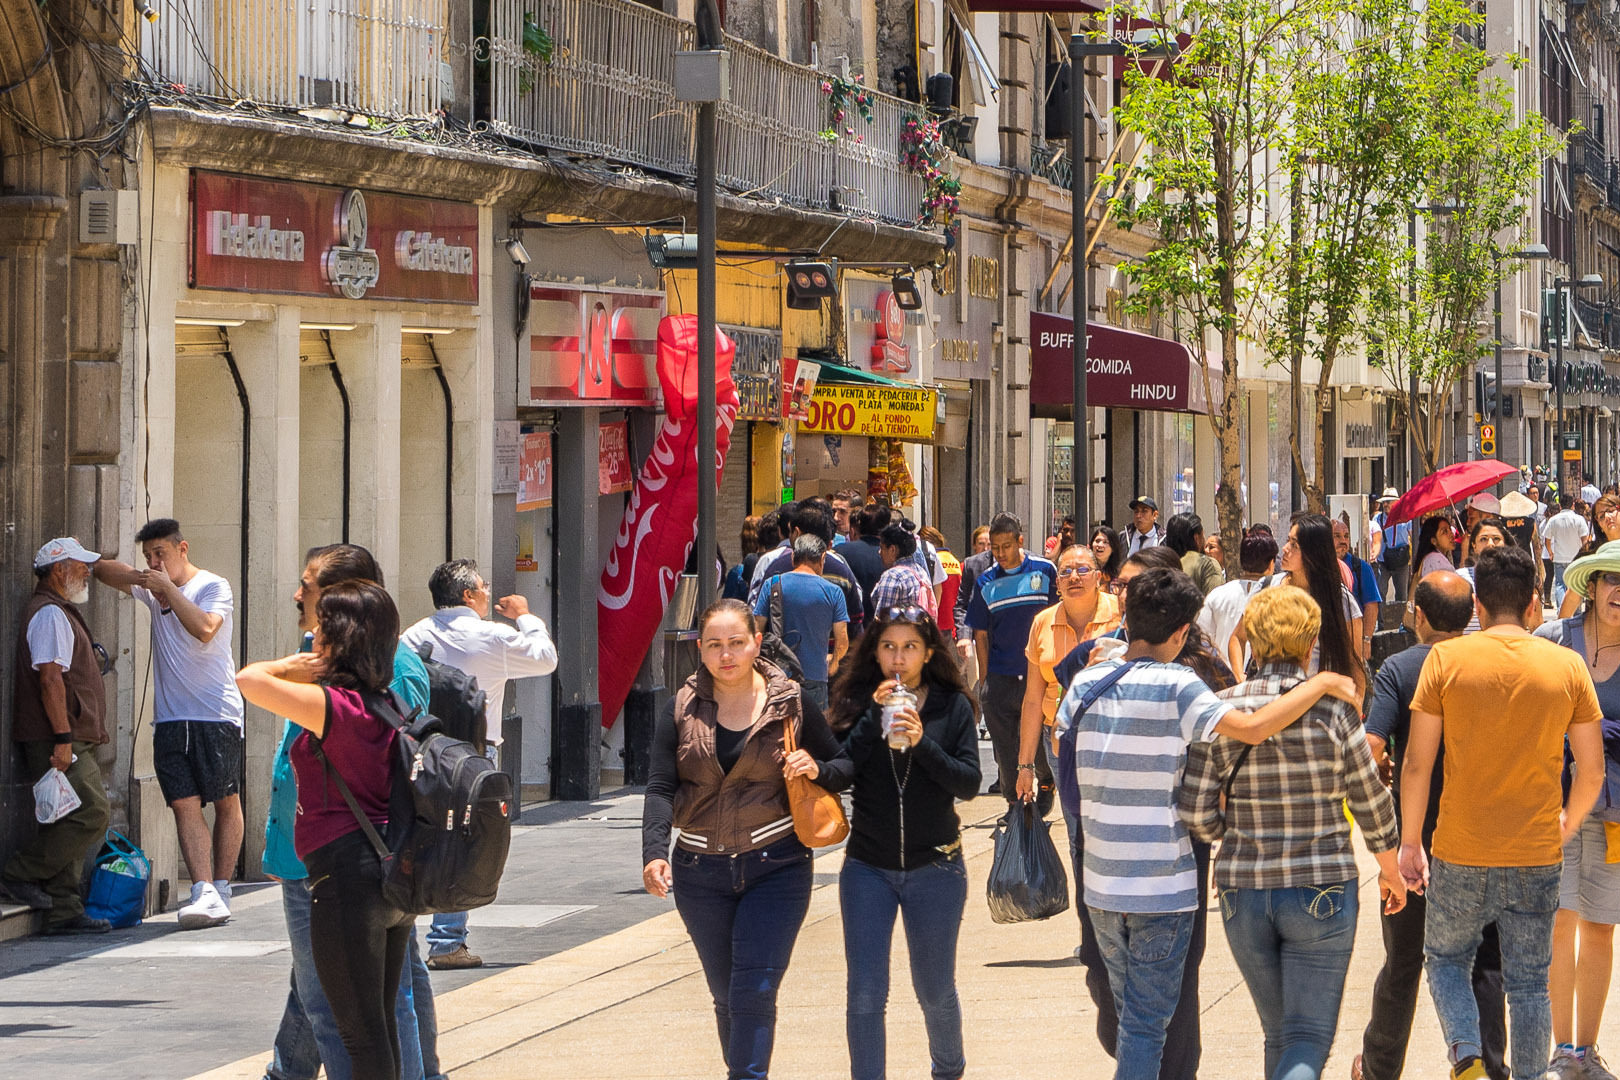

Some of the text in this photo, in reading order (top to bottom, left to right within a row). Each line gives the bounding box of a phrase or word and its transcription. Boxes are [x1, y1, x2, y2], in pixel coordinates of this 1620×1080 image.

[1040, 332, 1092, 350] BUFFT
[1086, 357, 1132, 375] COMIDA
[840, 388, 864, 399] VENTA
[867, 389, 878, 400] DE
[879, 390, 918, 401] PEDACERIA
[1131, 384, 1176, 400] HINDU
[858, 400, 925, 412] PLATA MONEDAS
[803, 400, 856, 431] ORO
[871, 413, 911, 424] AL FONDO
[861, 423, 920, 434] DE LA TIENDITA
